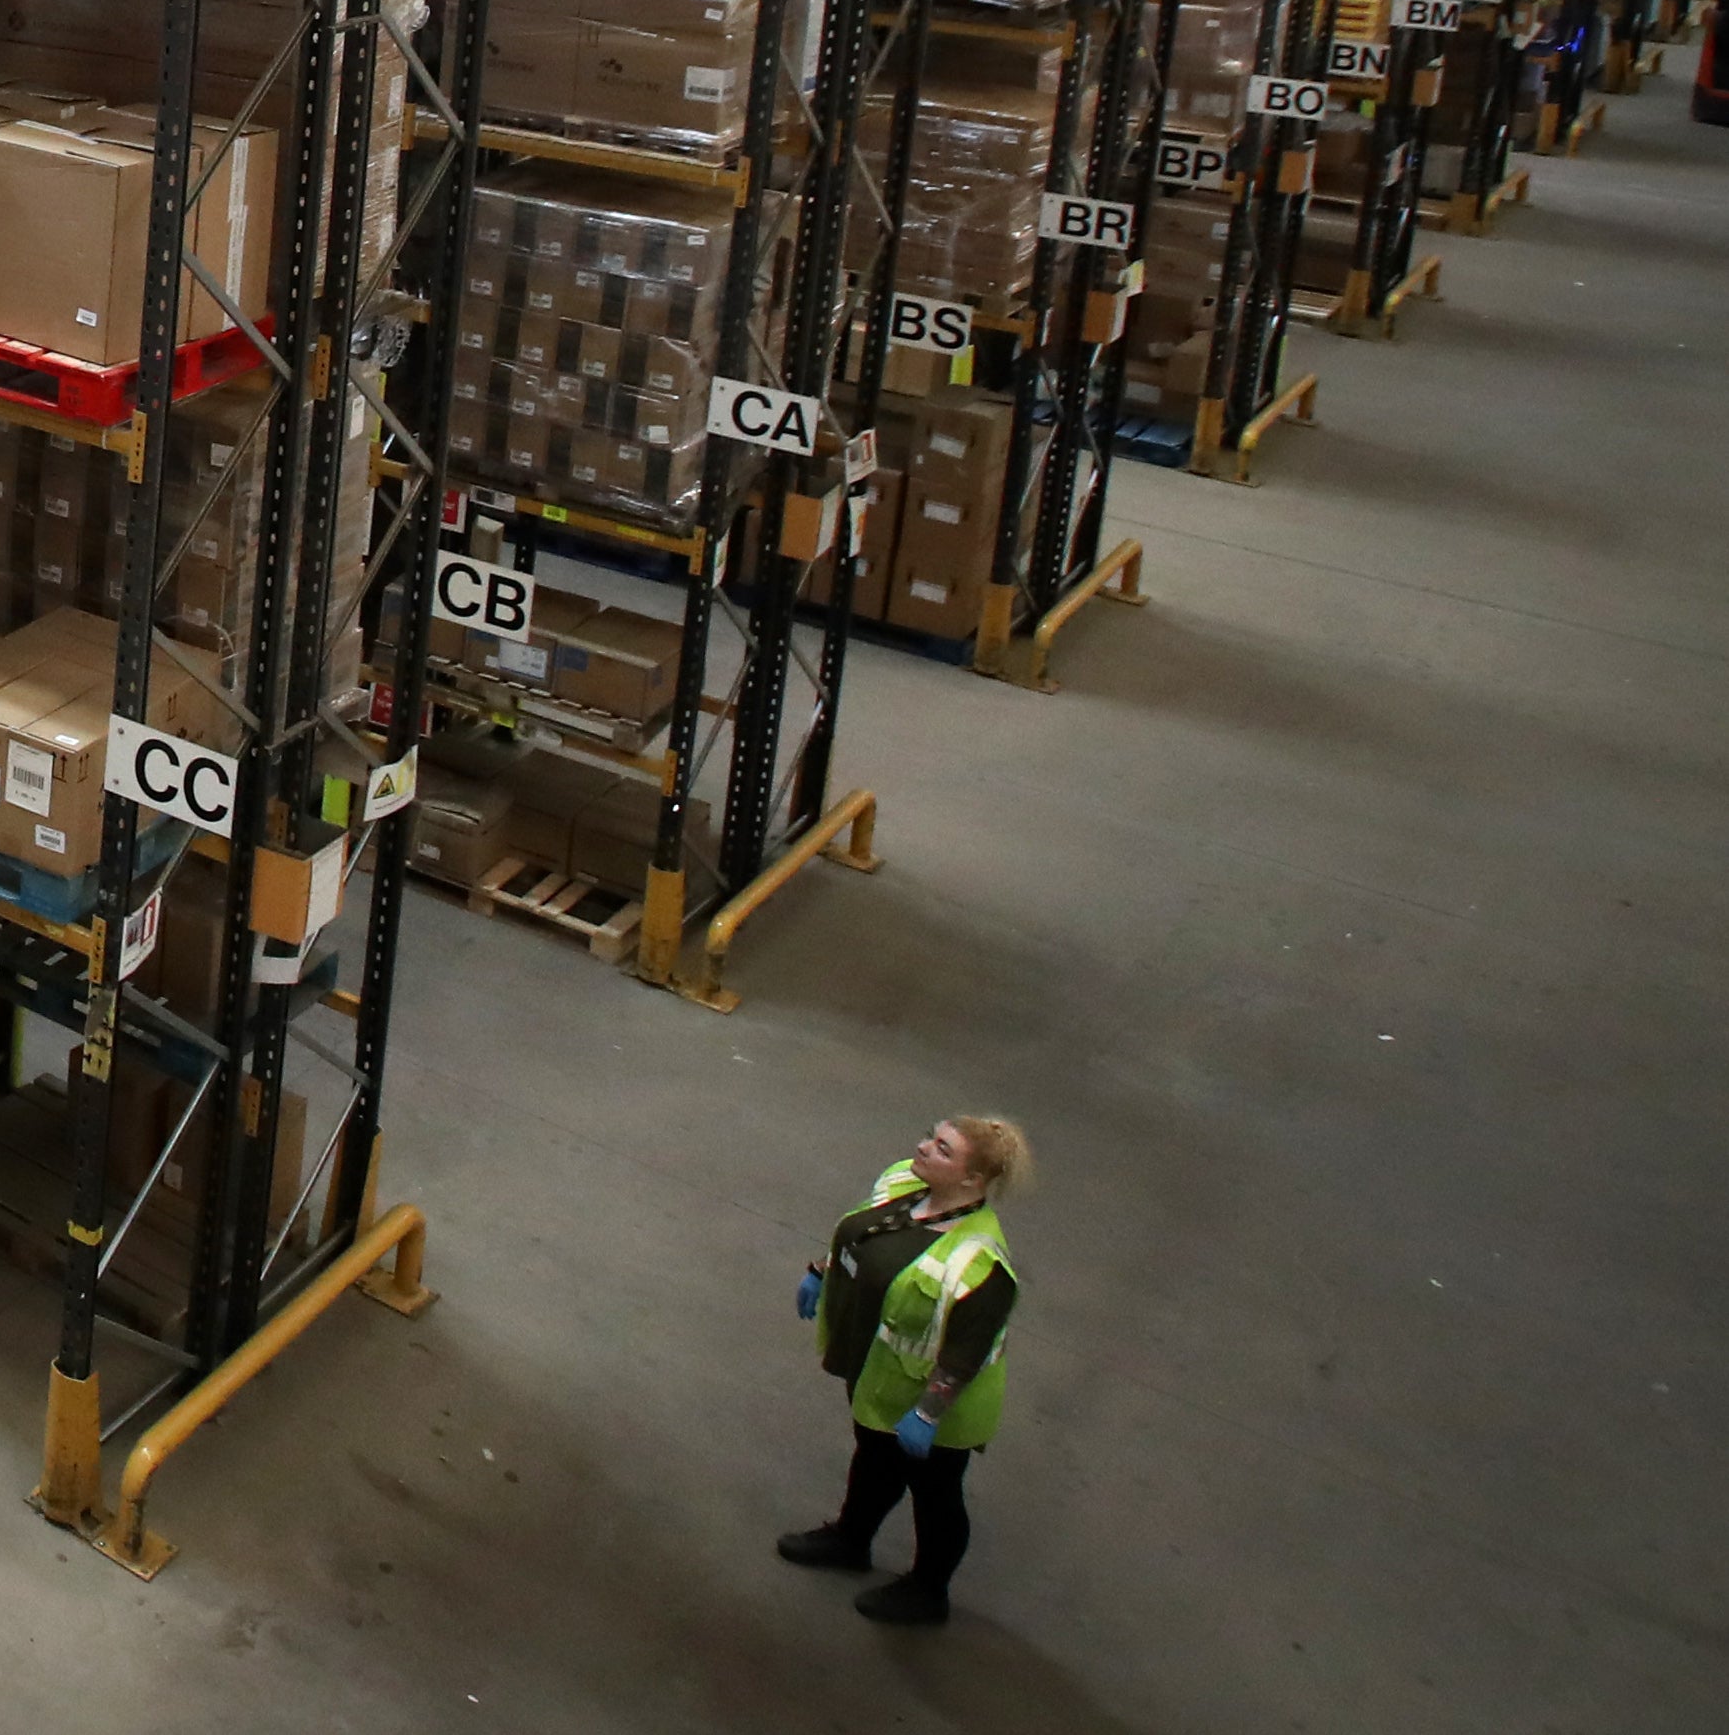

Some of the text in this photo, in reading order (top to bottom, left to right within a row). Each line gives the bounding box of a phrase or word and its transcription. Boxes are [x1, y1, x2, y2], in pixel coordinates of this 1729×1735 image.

[1407, 0, 1462, 28] BM
[1333, 44, 1387, 75] BN
[1264, 81, 1325, 115] BO
[1159, 144, 1223, 181] BP
[1059, 201, 1129, 244] BR
[891, 299, 968, 350] BS
[731, 390, 810, 450] CA
[437, 561, 527, 632] CB
[134, 738, 230, 823] CC
